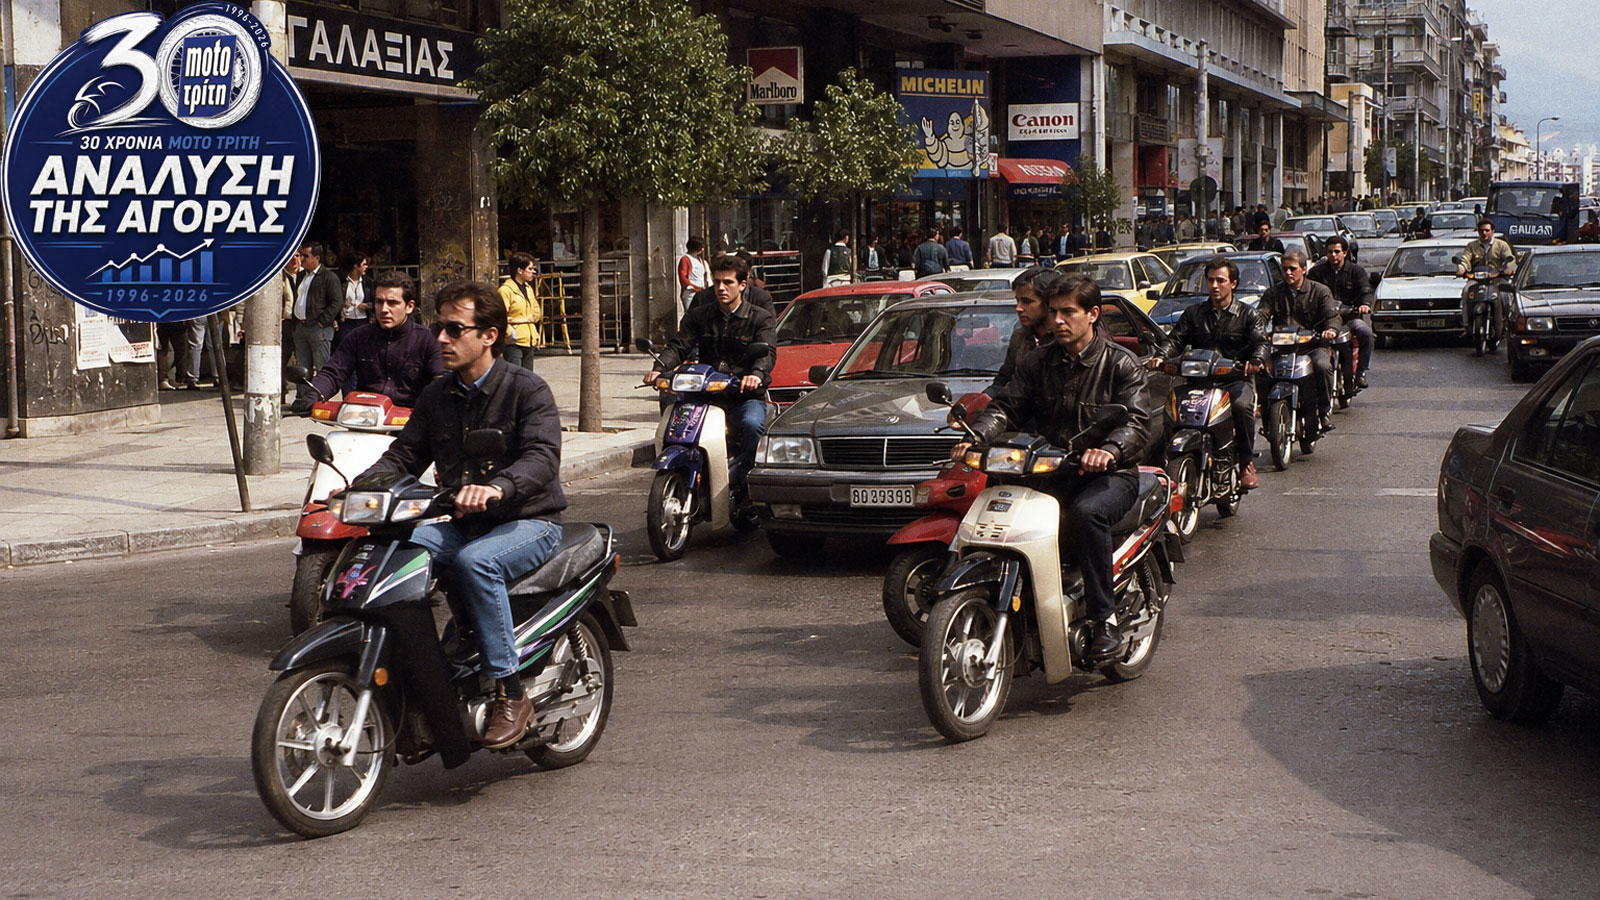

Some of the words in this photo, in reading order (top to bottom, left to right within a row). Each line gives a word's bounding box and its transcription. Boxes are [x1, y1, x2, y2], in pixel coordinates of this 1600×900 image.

[287, 14, 455, 80] ΓΑΛΑΞΙΑΣ
[750, 81, 797, 99] Marlboro
[901, 76, 985, 94] MICHELIN
[1012, 113, 1074, 127] Canon
